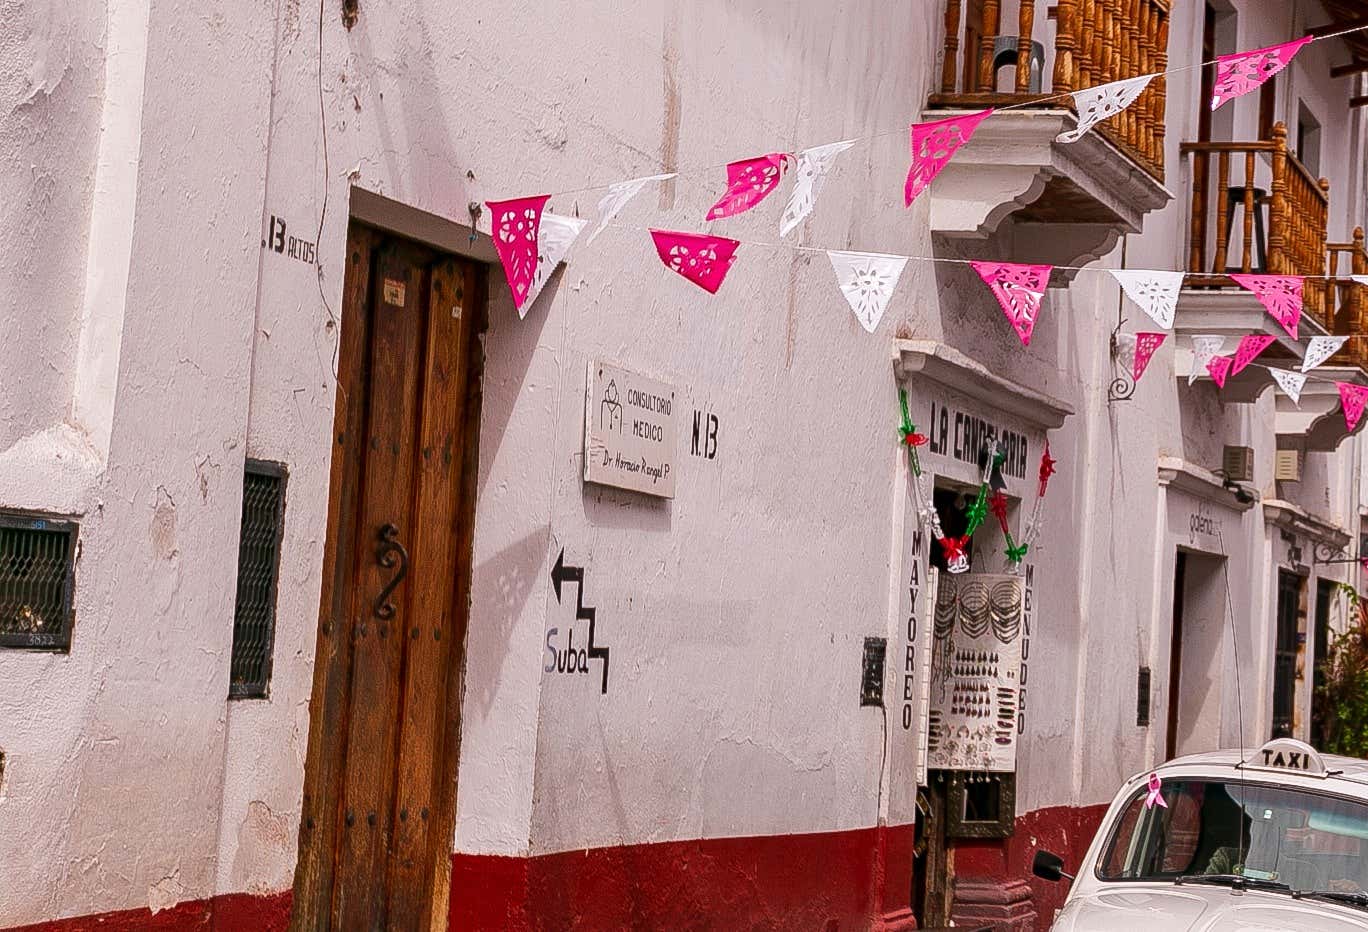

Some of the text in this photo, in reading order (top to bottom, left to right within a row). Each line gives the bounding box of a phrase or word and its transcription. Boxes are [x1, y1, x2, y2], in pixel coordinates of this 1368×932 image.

[287, 235, 315, 265] ALTOS
[627, 388, 672, 417] CONSULTORIO
[632, 418, 663, 443] MEDICO
[929, 401, 949, 457] LA
[902, 531, 922, 730] MAYOREO
[1017, 564, 1034, 735] MENUDEO
[545, 627, 589, 674] Suba
[1262, 749, 1310, 770] TAXI
